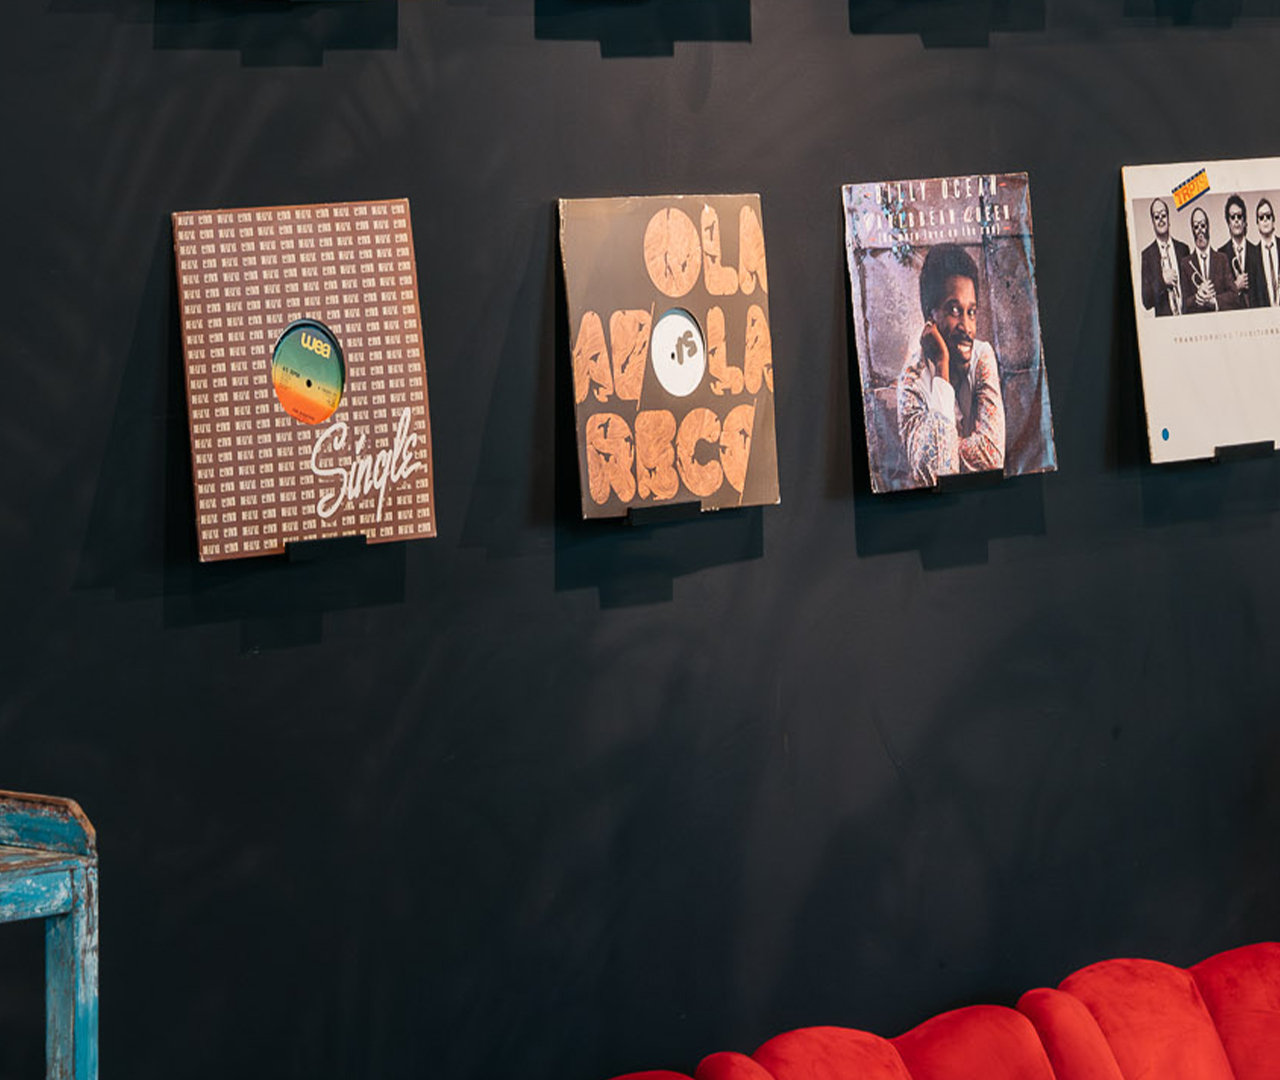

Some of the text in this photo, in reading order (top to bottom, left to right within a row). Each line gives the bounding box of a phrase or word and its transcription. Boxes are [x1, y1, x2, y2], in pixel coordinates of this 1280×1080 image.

[875, 174, 997, 206] BILLY OCEAN
[963, 204, 1010, 224] QUEEN
[301, 332, 333, 360] wea
[311, 407, 423, 523] Single
